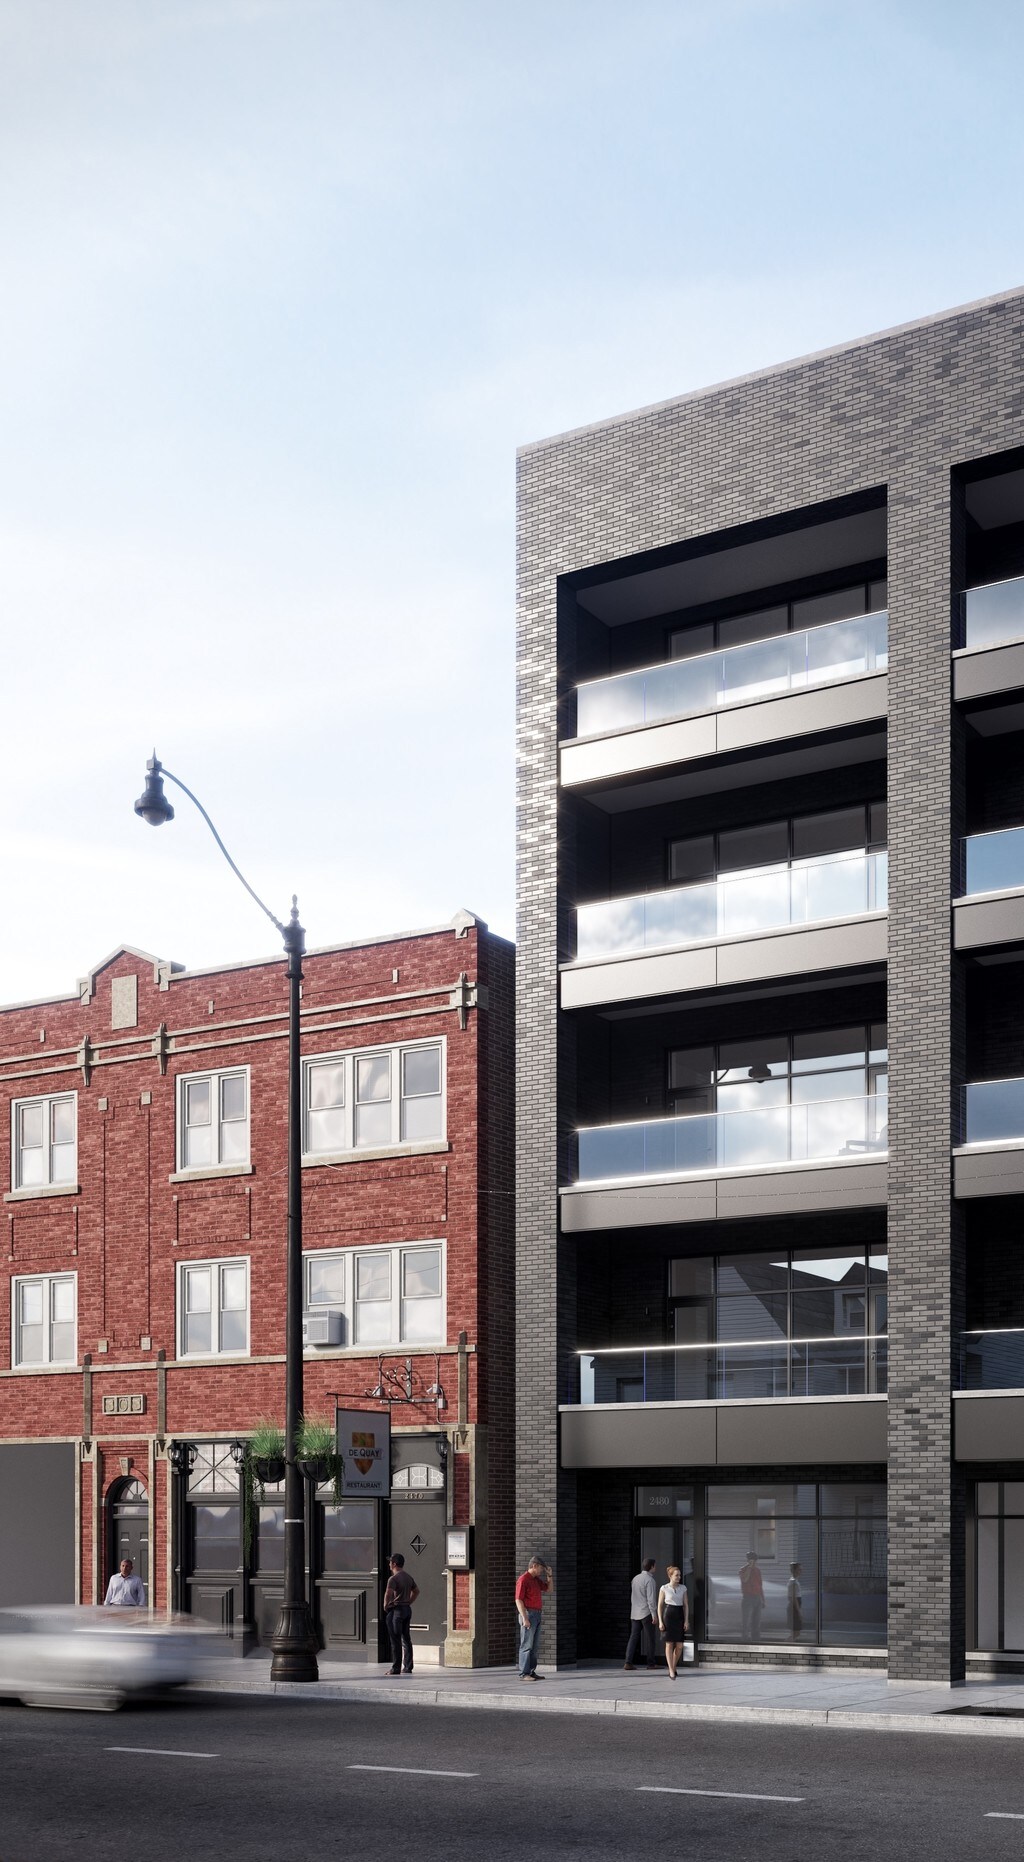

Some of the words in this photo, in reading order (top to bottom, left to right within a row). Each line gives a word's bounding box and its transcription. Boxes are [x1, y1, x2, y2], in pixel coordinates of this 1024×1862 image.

[348, 1449, 358, 1457] DE
[360, 1448, 380, 1458] QUAY
[346, 1481, 380, 1489] RESTAURANT
[649, 1496, 670, 1506] 2480
